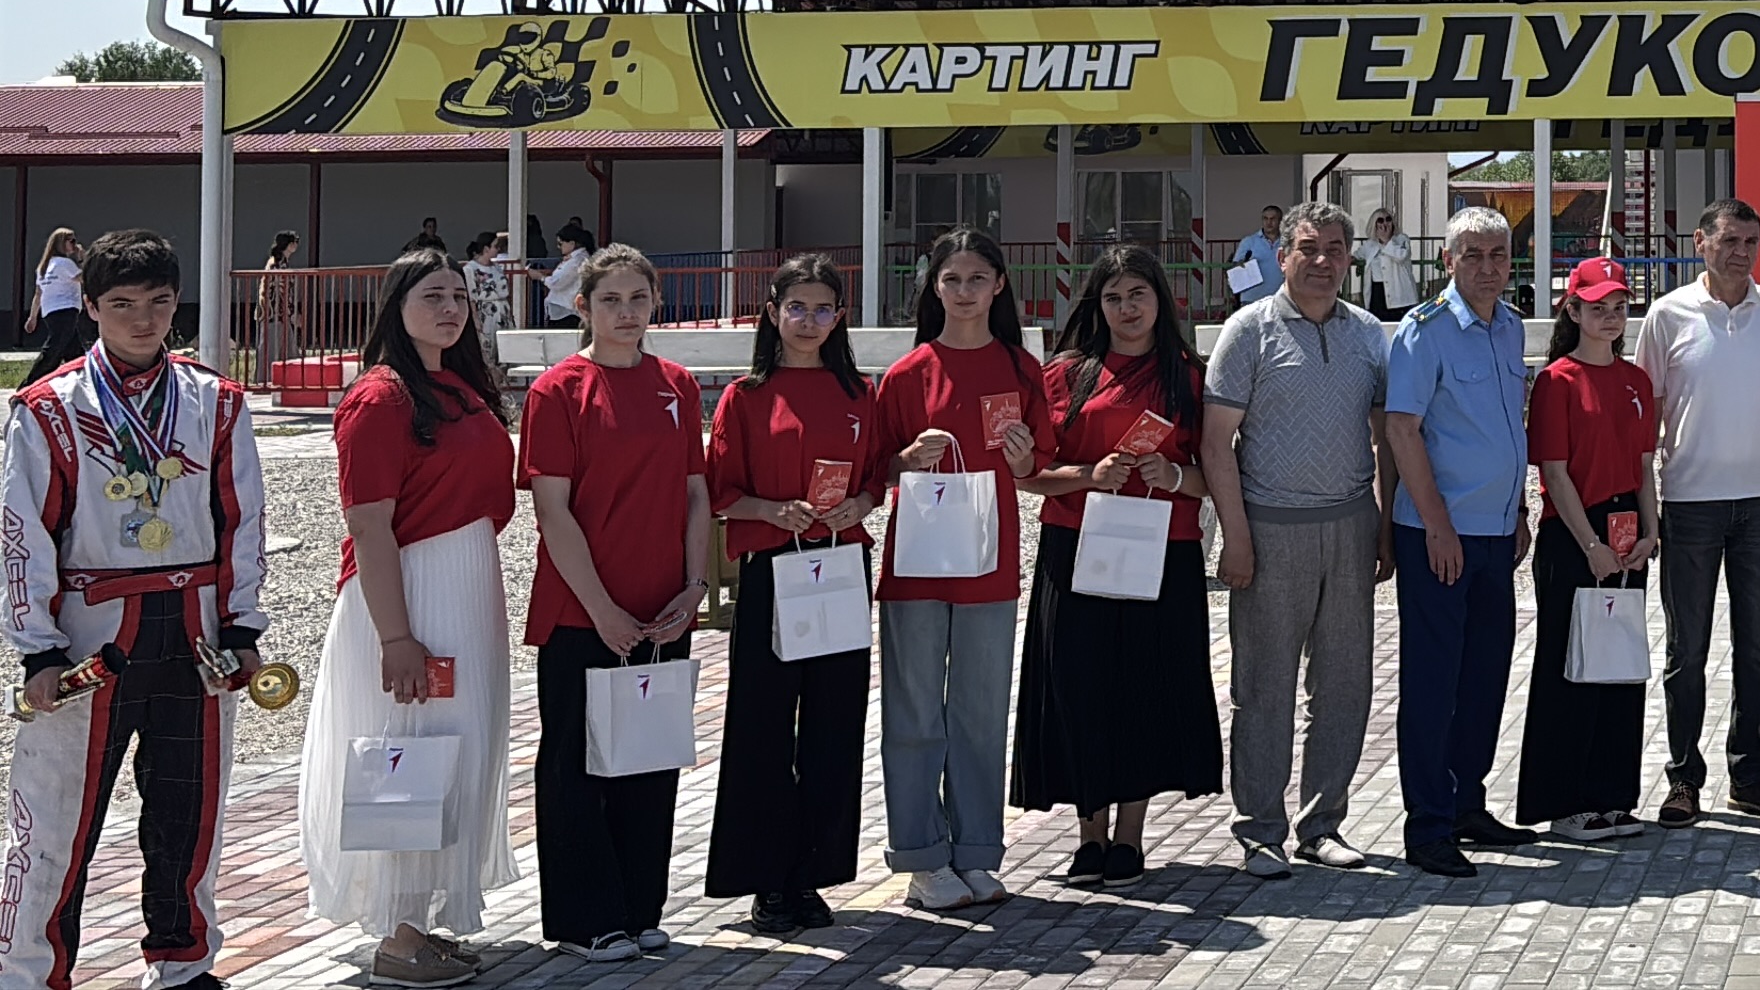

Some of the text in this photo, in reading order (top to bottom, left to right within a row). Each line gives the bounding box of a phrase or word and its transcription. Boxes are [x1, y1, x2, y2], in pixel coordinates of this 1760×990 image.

[841, 40, 1160, 94] КАРТИНГ
[38, 397, 72, 463] AXCEL
[3, 505, 31, 632] AXCEL
